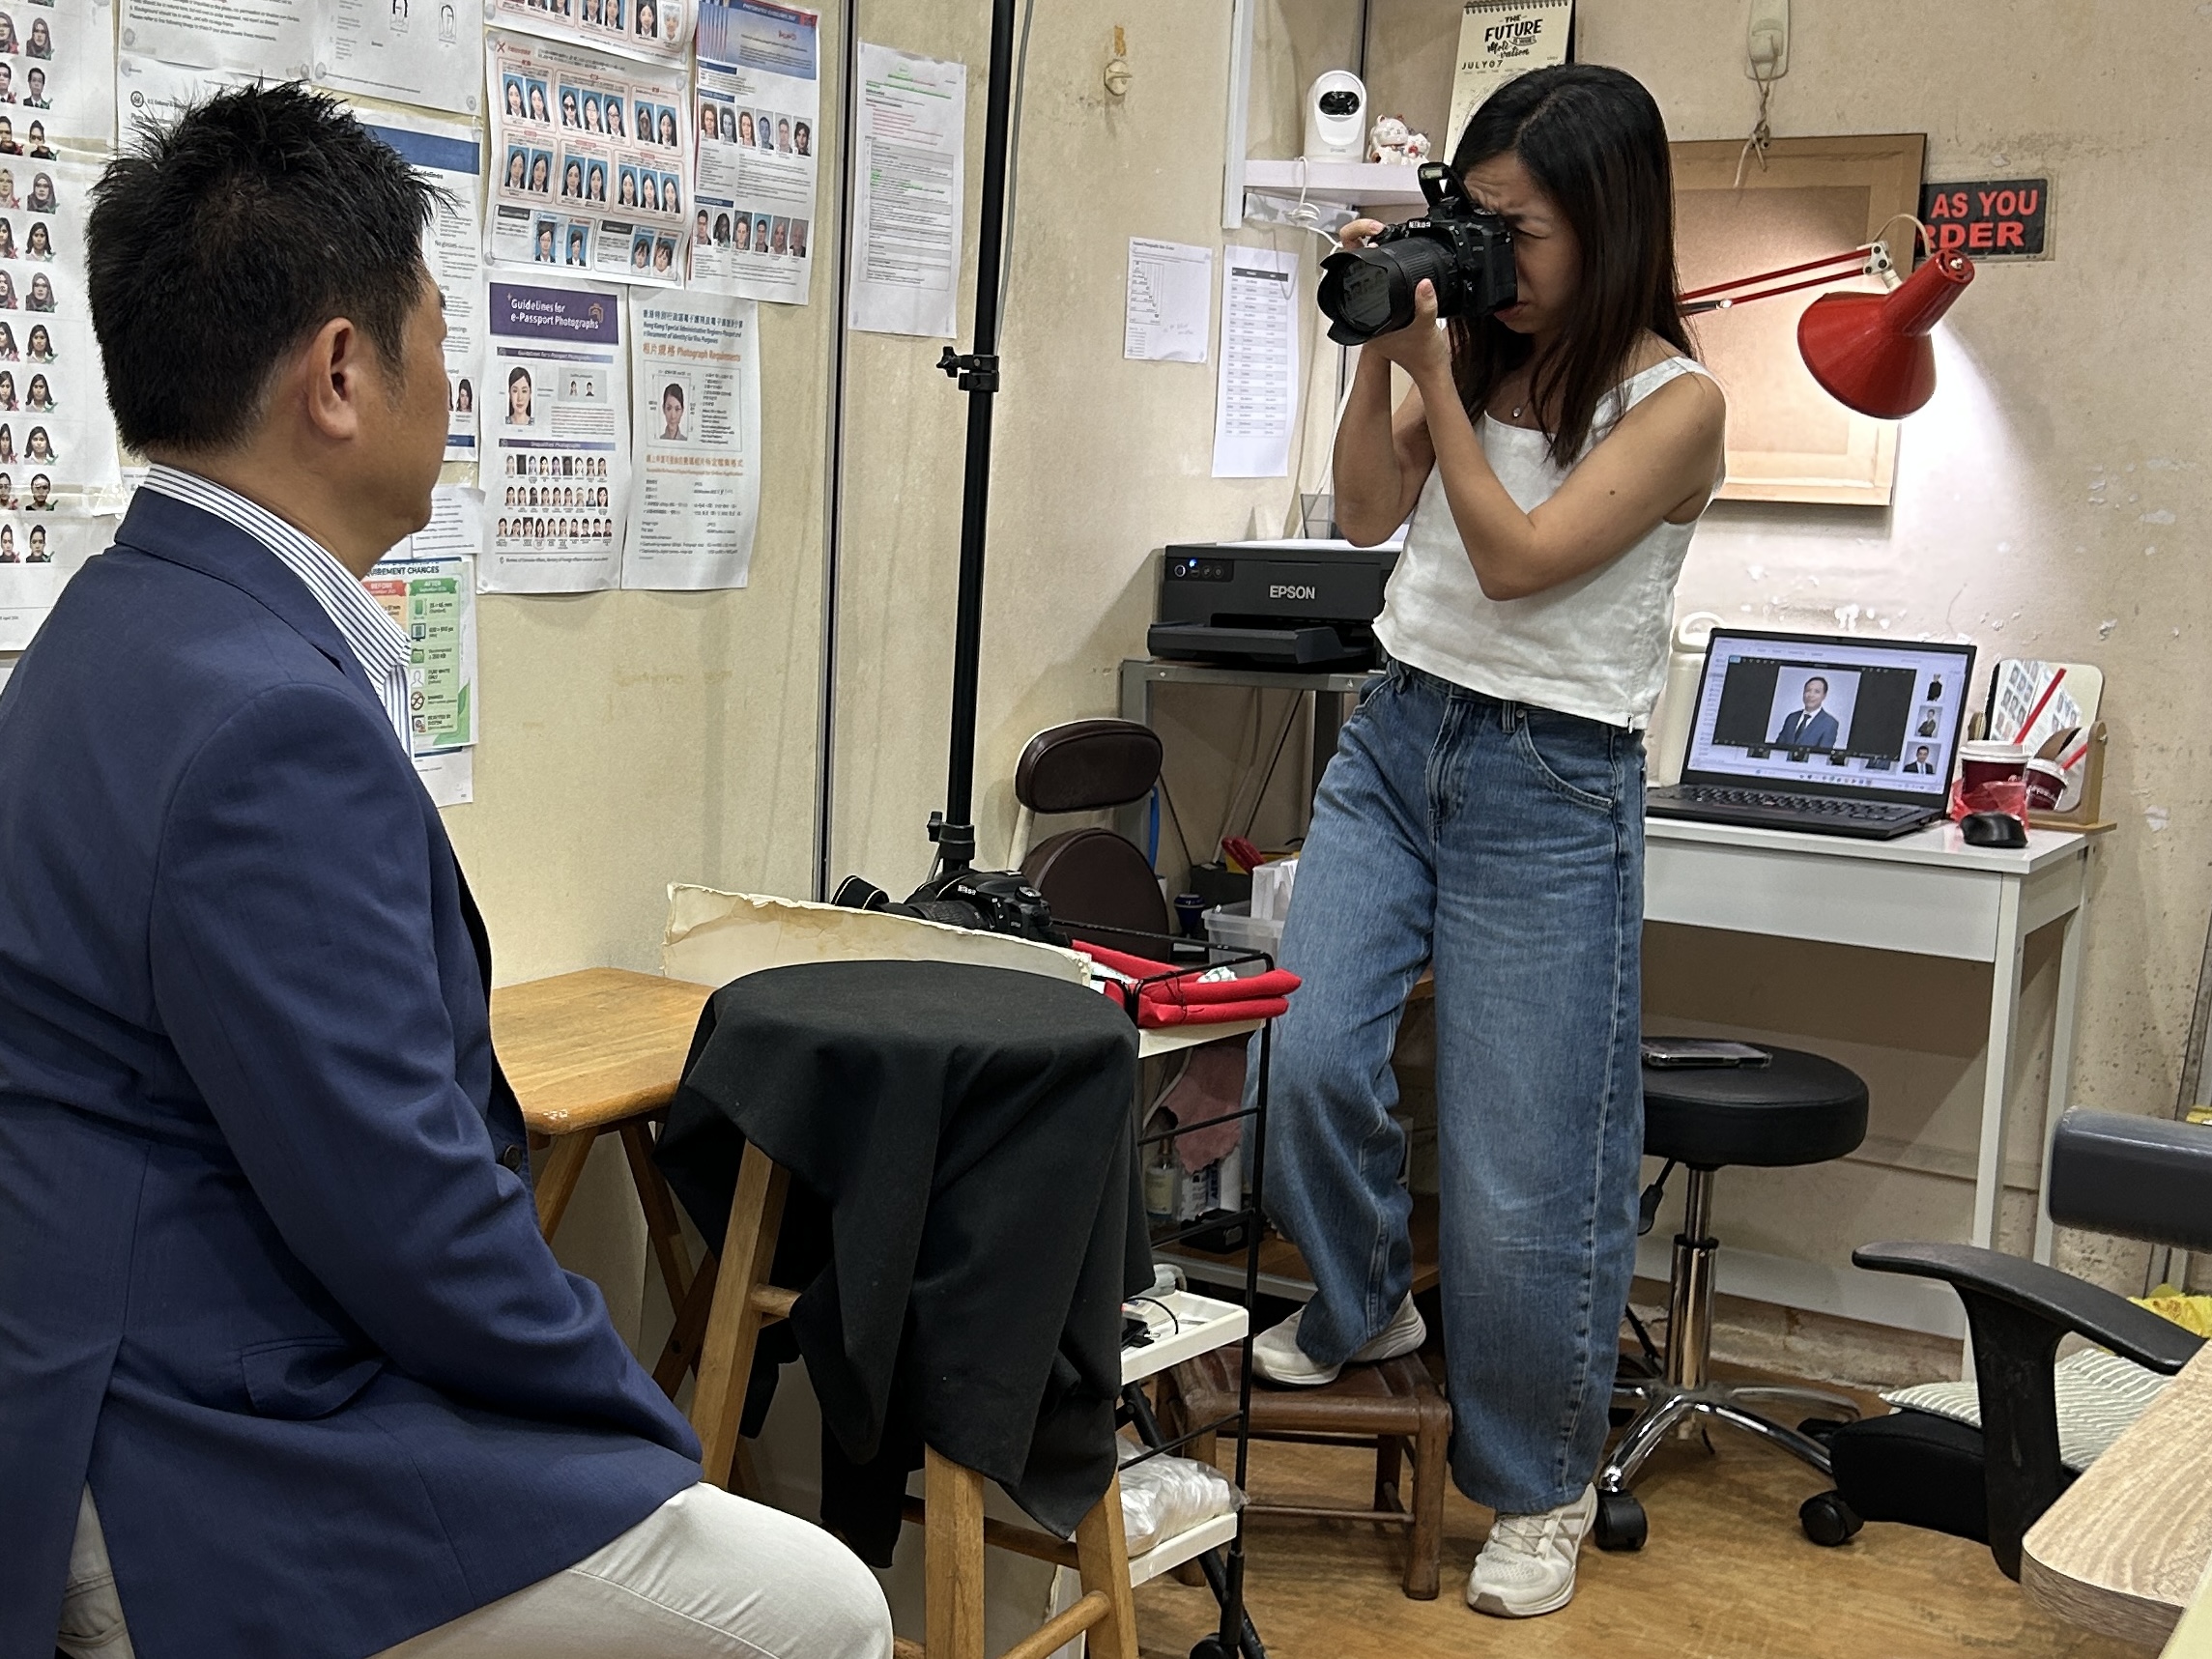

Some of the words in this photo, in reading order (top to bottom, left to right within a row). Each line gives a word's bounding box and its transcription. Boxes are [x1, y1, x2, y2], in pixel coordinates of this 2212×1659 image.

[1505, 14, 1521, 23] THE
[1484, 19, 1543, 43] FUTURE
[1931, 192, 1968, 218] AS
[1978, 189, 2038, 216] YOU
[1917, 221, 2025, 248] RDER
[511, 299, 554, 313] Guidelines
[555, 301, 566, 313] for
[510, 312, 555, 326] e-Passport
[555, 316, 599, 330] Photographs
[407, 565, 440, 575] CHANGES
[1269, 585, 1315, 600] EPSON
